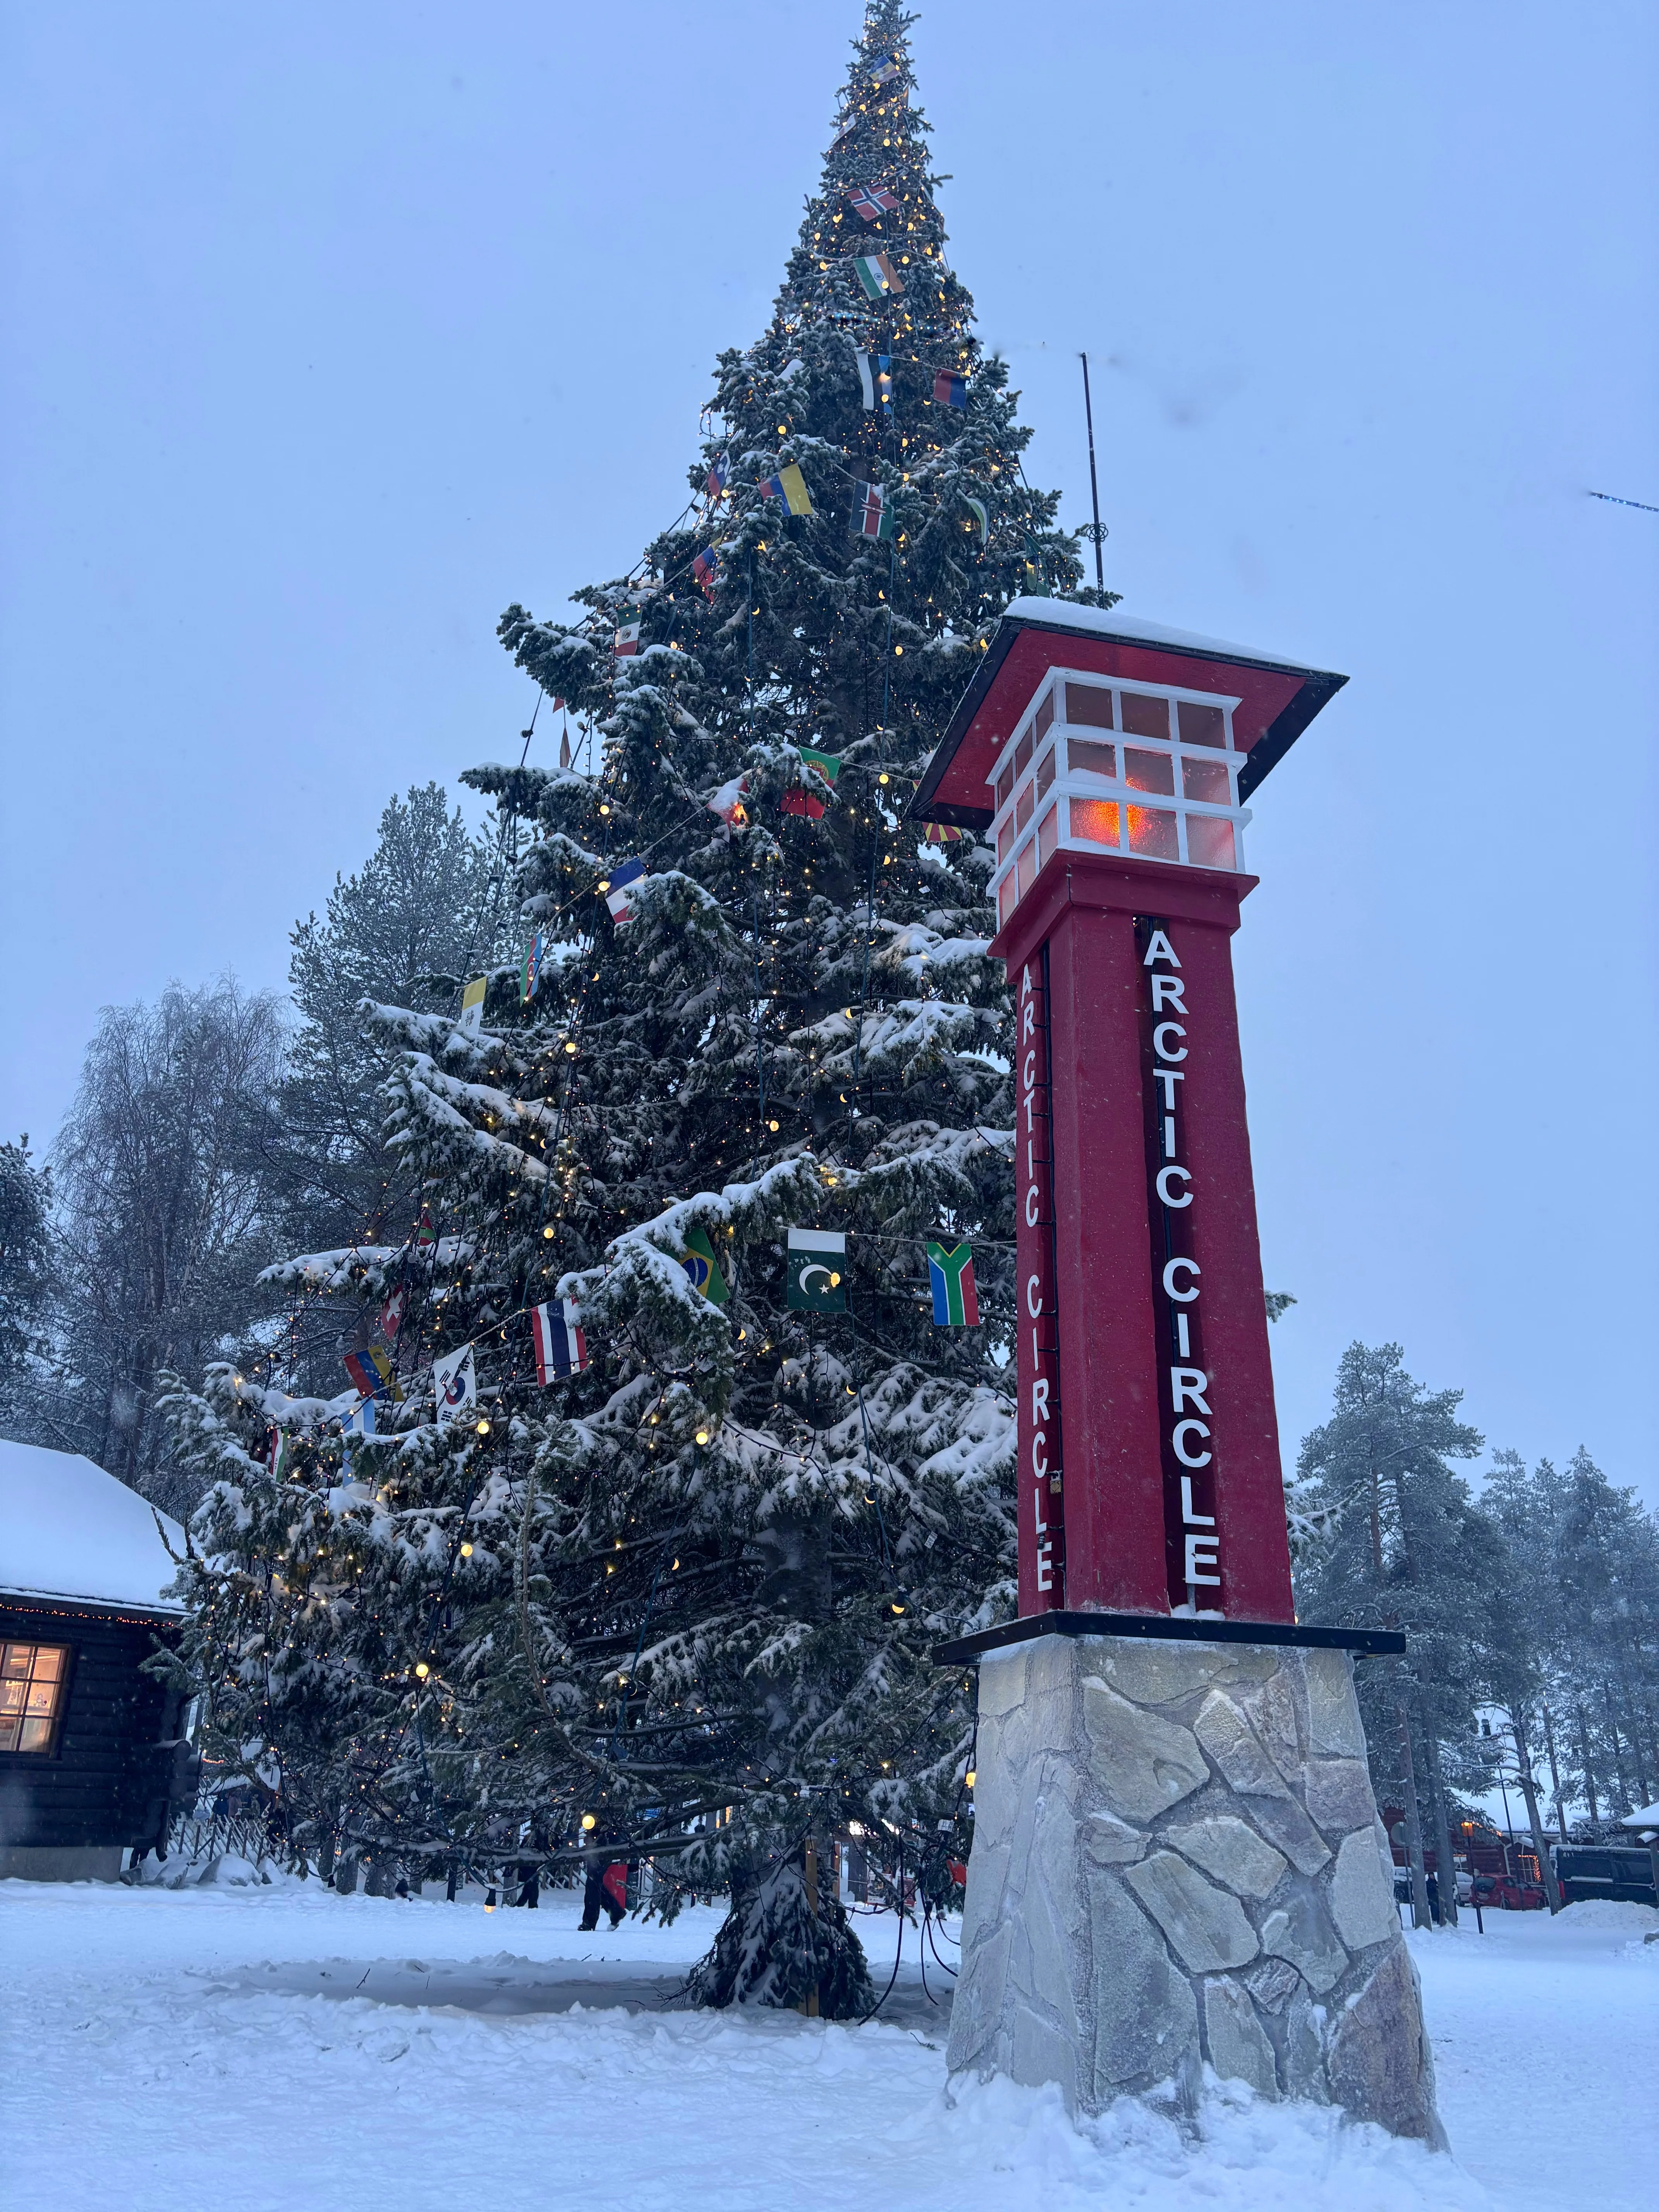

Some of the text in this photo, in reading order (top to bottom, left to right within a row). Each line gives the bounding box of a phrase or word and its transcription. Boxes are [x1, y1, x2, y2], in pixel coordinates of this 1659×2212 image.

[1020, 963, 1053, 1592] ARCTIC CIRCLE
[1143, 930, 1220, 1586] ARCTIC CIRCLE
